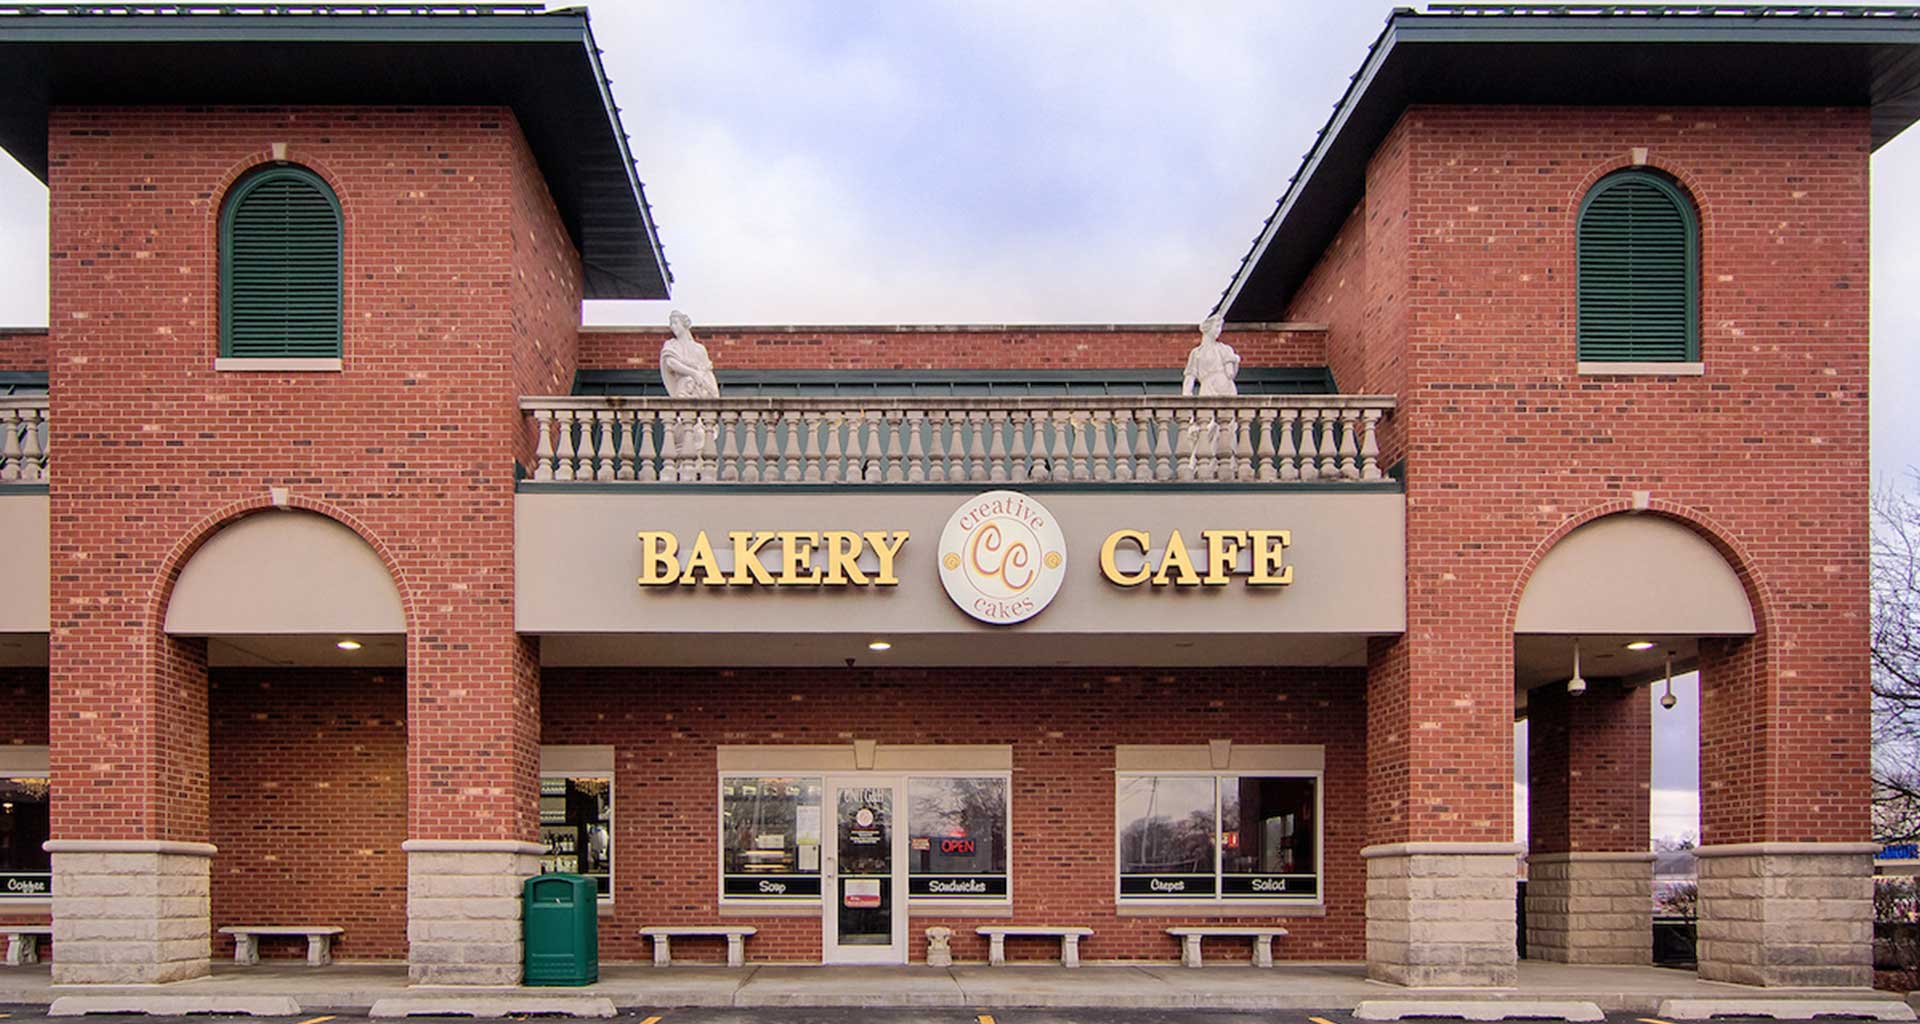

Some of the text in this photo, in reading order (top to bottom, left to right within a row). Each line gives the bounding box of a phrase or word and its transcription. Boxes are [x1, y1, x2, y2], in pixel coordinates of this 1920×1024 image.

[959, 497, 1044, 531] creative
[638, 529, 909, 588] BAKERY
[1100, 528, 1294, 588] CAFE
[974, 596, 1034, 618] cakes
[941, 839, 975, 853] OPEN
[8, 879, 45, 893] Coffee
[759, 880, 786, 894] Soup
[929, 879, 986, 892] Sandwiches
[1151, 879, 1184, 892] Crepes
[1252, 879, 1285, 891] Salad
